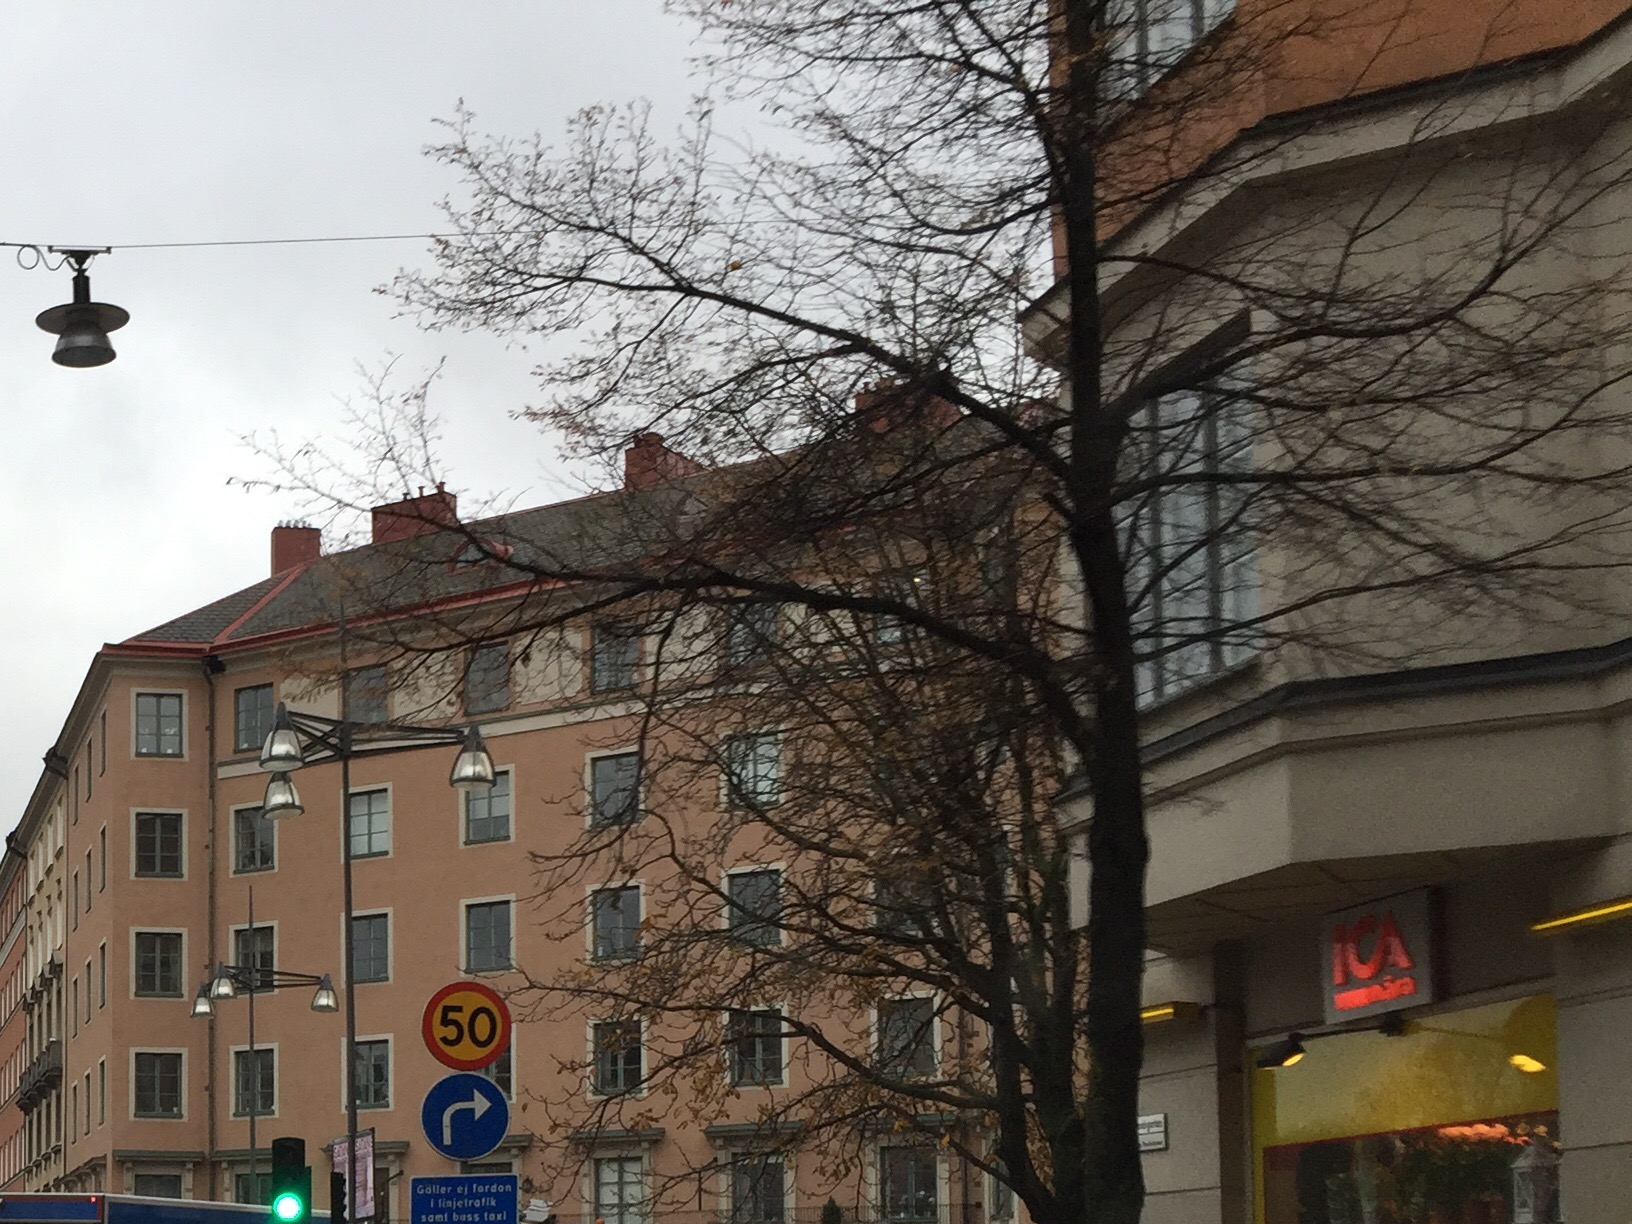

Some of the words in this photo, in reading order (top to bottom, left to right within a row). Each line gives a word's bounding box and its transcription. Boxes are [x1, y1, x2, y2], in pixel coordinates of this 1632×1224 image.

[1332, 909, 1414, 986] ICA
[439, 1005, 497, 1049] 50
[416, 1183, 452, 1195] Gäller
[456, 1184, 469, 1196] ej
[472, 1183, 512, 1194] fordon
[438, 1196, 497, 1210] linjetrafik
[420, 1212, 449, 1223] samt
[452, 1211, 480, 1222] buss
[483, 1210, 507, 1221] taxi
